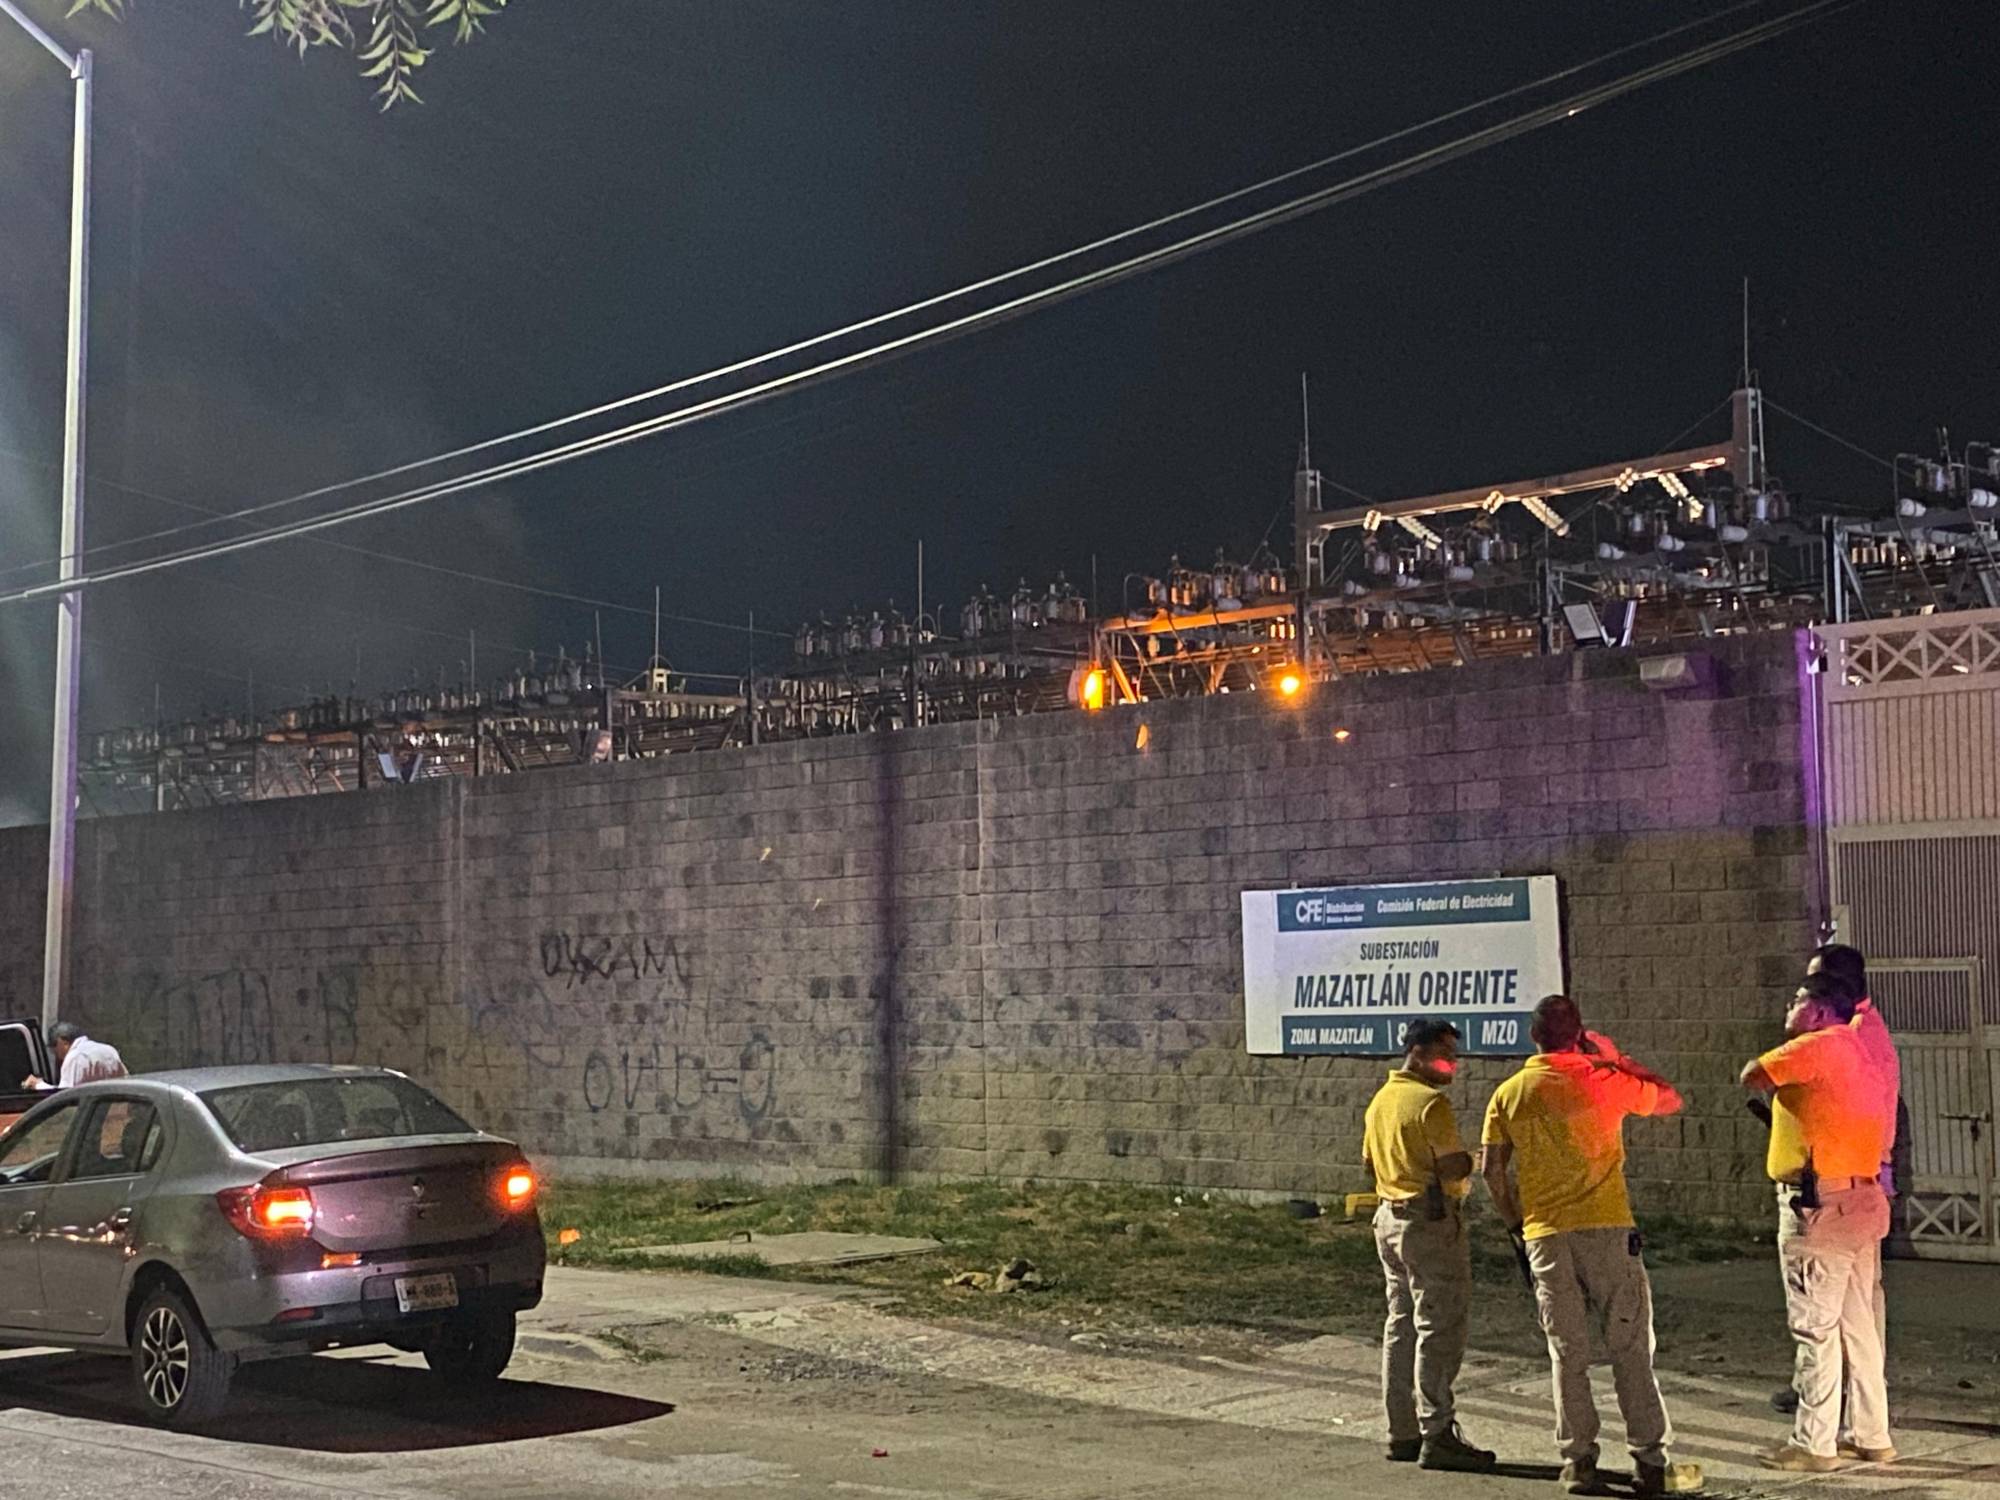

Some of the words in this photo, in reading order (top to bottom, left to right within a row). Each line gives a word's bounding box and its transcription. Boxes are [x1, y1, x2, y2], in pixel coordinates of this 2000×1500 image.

[1296, 899, 1323, 923] CFE
[1377, 898, 1414, 914] Comisión
[1416, 896, 1448, 911] Federal
[1449, 896, 1460, 910] de
[1462, 892, 1514, 909] Electricidad
[1360, 938, 1439, 960] SUBESTACIÓN
[1294, 964, 1411, 1008] MAZATLÁN
[1419, 969, 1518, 1006] ORIENTE
[1290, 1028, 1316, 1045] ZONA
[1319, 1024, 1374, 1044] MAZATLÁN
